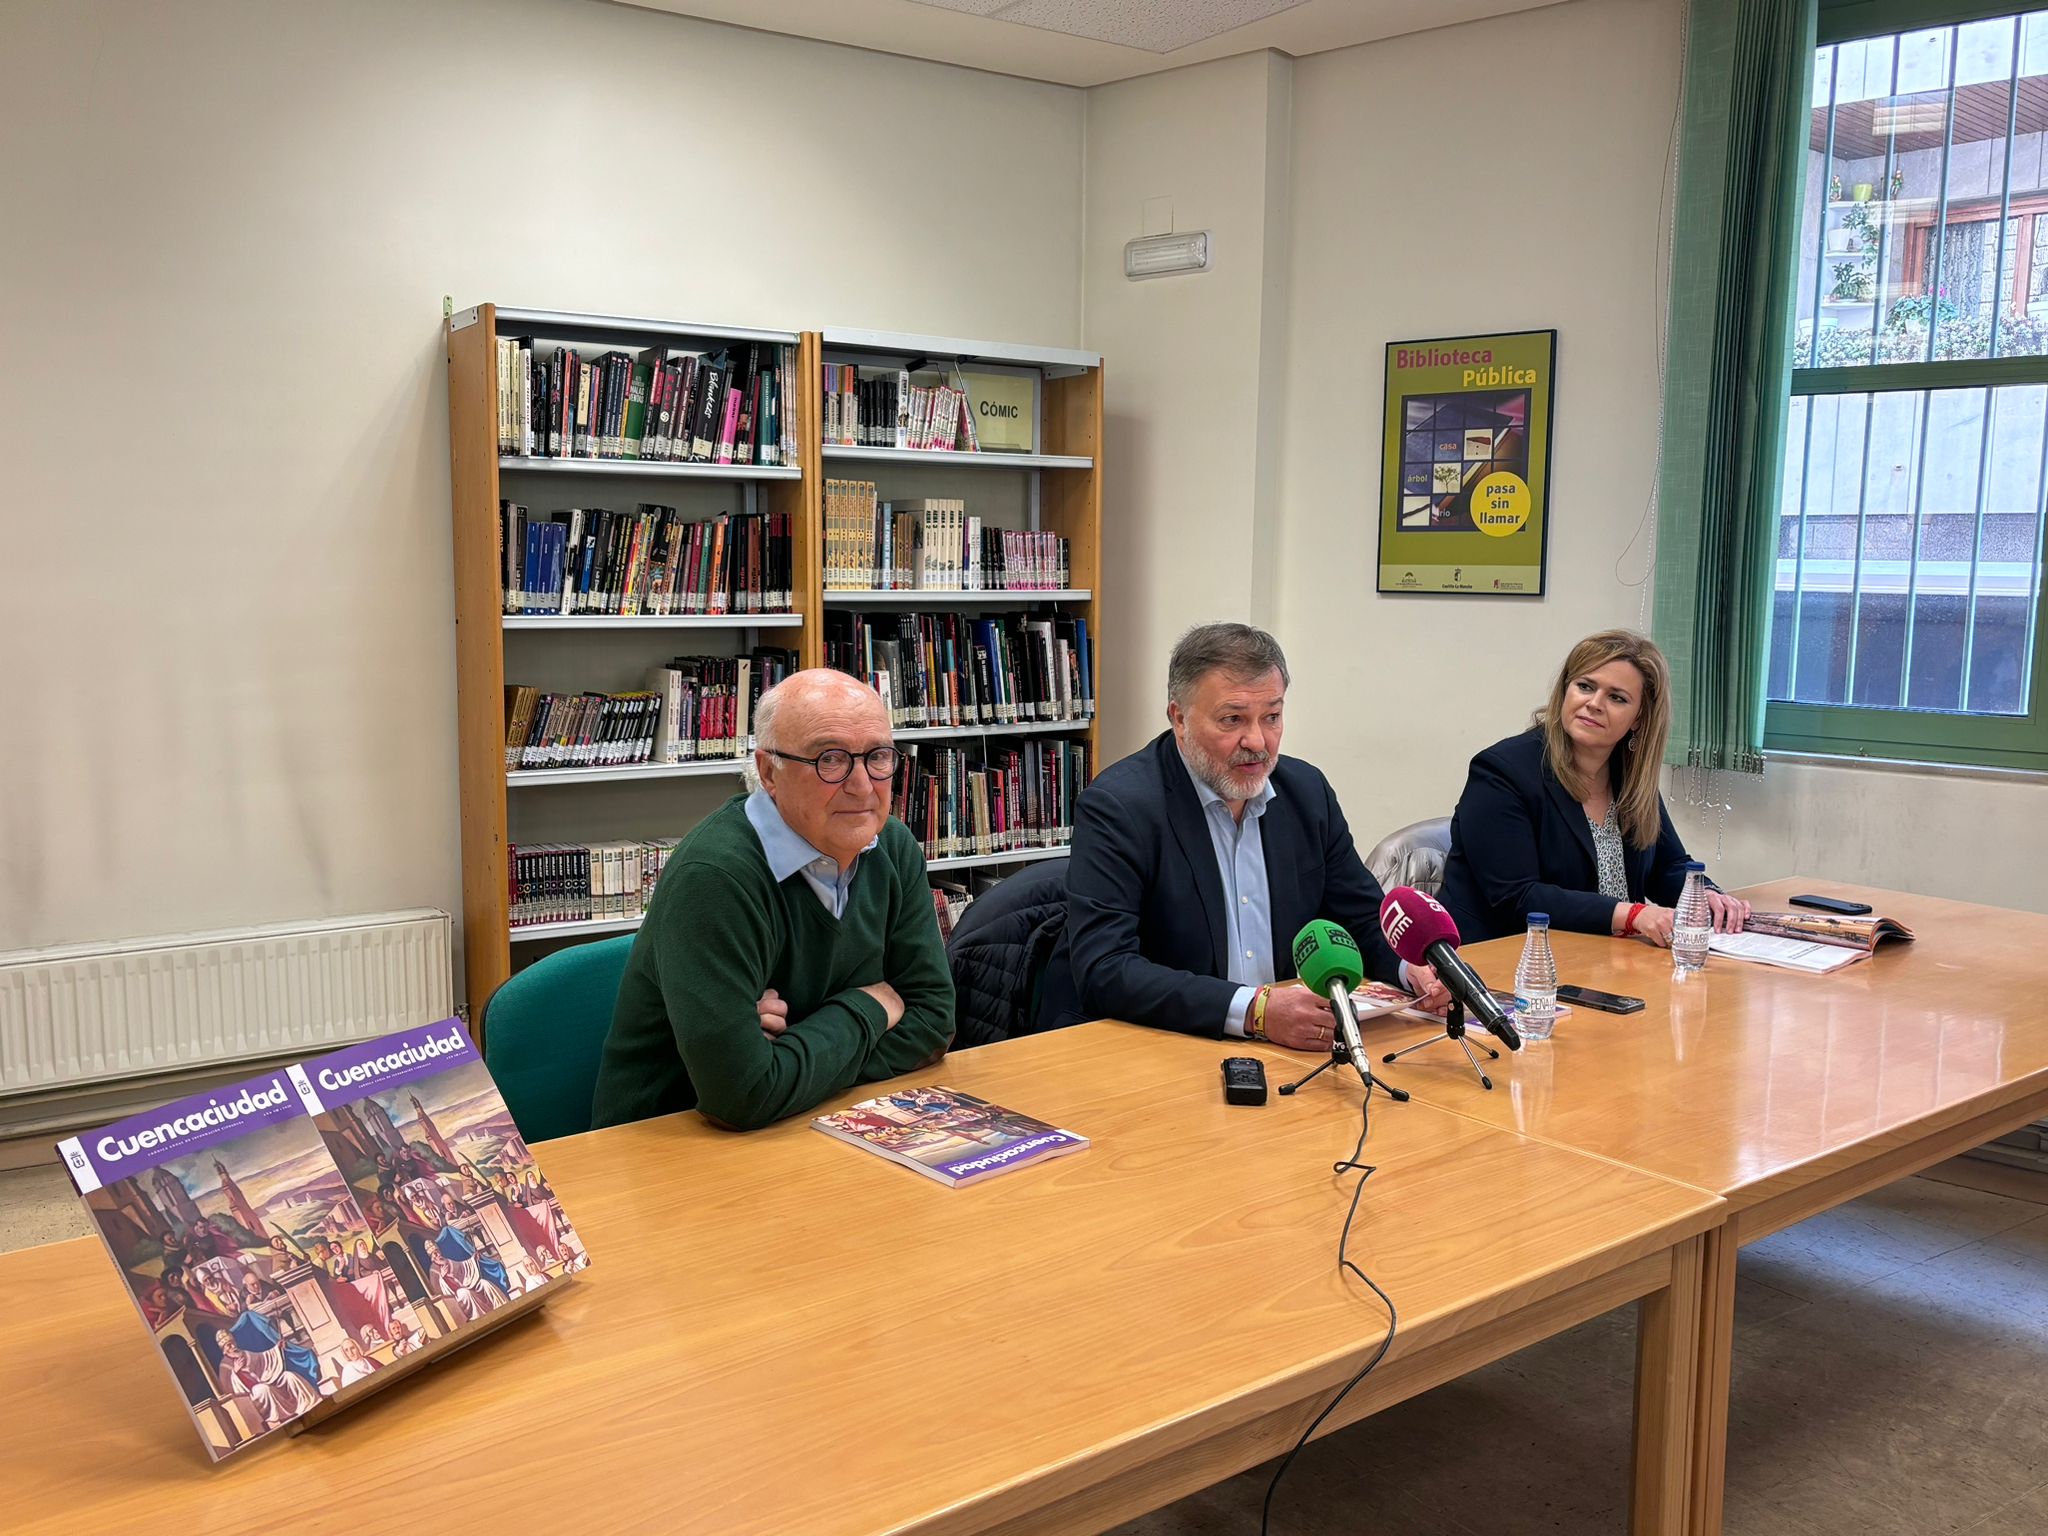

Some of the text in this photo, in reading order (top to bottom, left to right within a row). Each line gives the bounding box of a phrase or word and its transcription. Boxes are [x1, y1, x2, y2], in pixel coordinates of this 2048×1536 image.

[1396, 348, 1493, 369] Biblioteca
[1462, 366, 1537, 388] Pública
[980, 400, 1019, 419] CÓMIC
[1439, 442, 1457, 451] casa
[1407, 473, 1428, 483] árbol
[1486, 484, 1516, 498] pasa
[1490, 497, 1510, 510] sin
[1479, 511, 1520, 525] llamar
[1389, 916, 1414, 949] cmm
[318, 1026, 466, 1091] Cuencaciudad
[96, 1078, 290, 1162] Cuencaciudad
[948, 1134, 1068, 1176] Cuencaciudad
